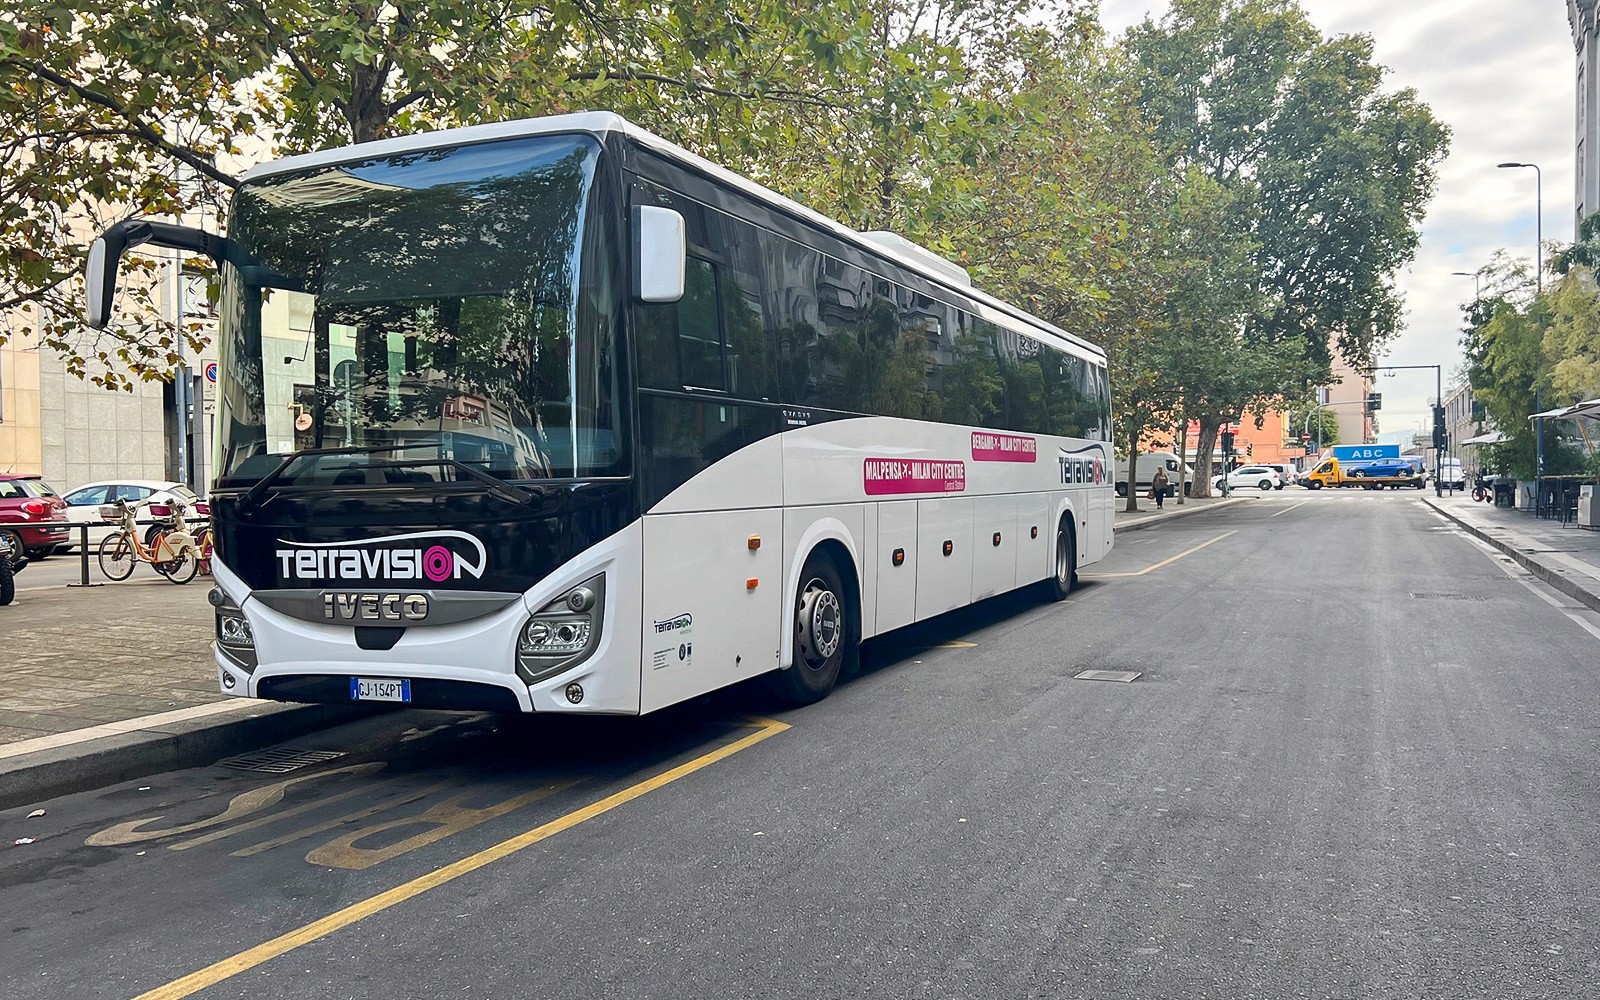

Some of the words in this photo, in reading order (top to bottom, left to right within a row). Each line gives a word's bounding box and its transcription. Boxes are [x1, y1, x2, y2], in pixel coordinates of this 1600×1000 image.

[972, 434, 994, 450] BERGAMO
[1000, 436, 1013, 451] MILAN
[1013, 437, 1022, 452] CITY
[1022, 439, 1036, 453] CENTRE
[1352, 449, 1383, 458] ABC
[865, 461, 903, 480] MALPENSA
[911, 462, 931, 480] MILAN
[931, 463, 944, 480] CITY
[944, 463, 964, 479] CENTRE
[324, 593, 429, 620] IVECO
